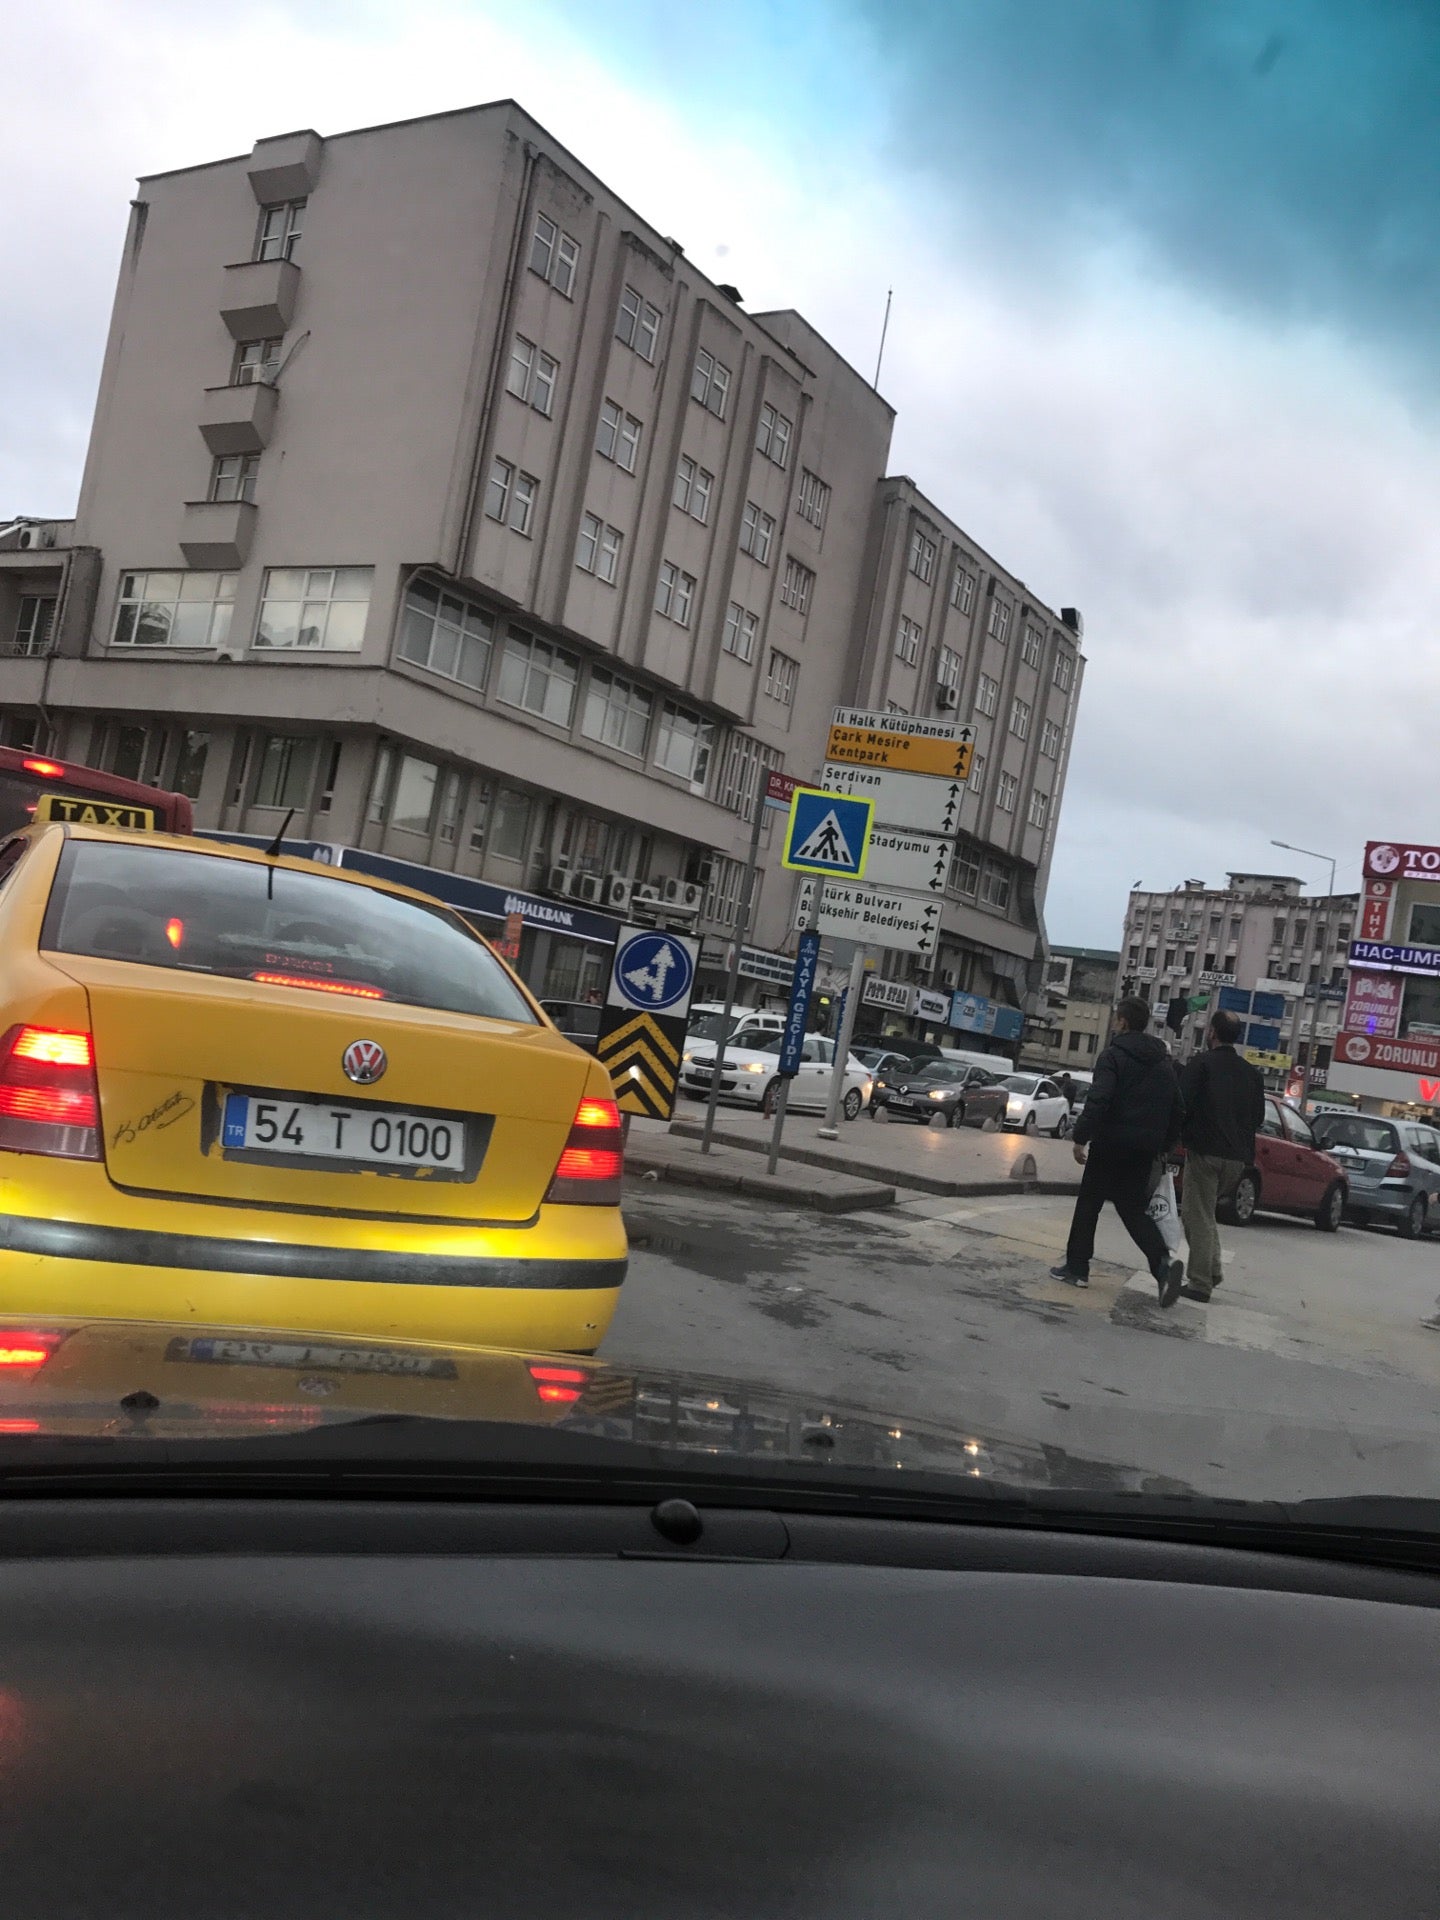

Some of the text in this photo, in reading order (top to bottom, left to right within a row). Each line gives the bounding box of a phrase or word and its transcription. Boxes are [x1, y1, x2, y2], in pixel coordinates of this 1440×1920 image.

[849, 713, 876, 728] Halk
[880, 718, 956, 738] Kütüphanesi
[830, 744, 889, 762] Kentpark
[867, 733, 911, 750] Mesire
[826, 767, 882, 786] Serdivan
[59, 801, 136, 832] TAXI
[869, 833, 930, 854] Stadyumu
[803, 884, 902, 911] Atürk Bulvarı
[516, 900, 574, 927] HALKBANK
[800, 900, 920, 931] Bükşehir Belediyesi
[1368, 902, 1382, 938] THY
[796, 957, 813, 999] YAYA
[1201, 972, 1236, 983] AVUKAT
[1348, 1000, 1399, 1016] ZORUNLU
[1374, 1044, 1439, 1069] ZORUNLU
[227, 1104, 451, 1161] TR 54 T 0100
